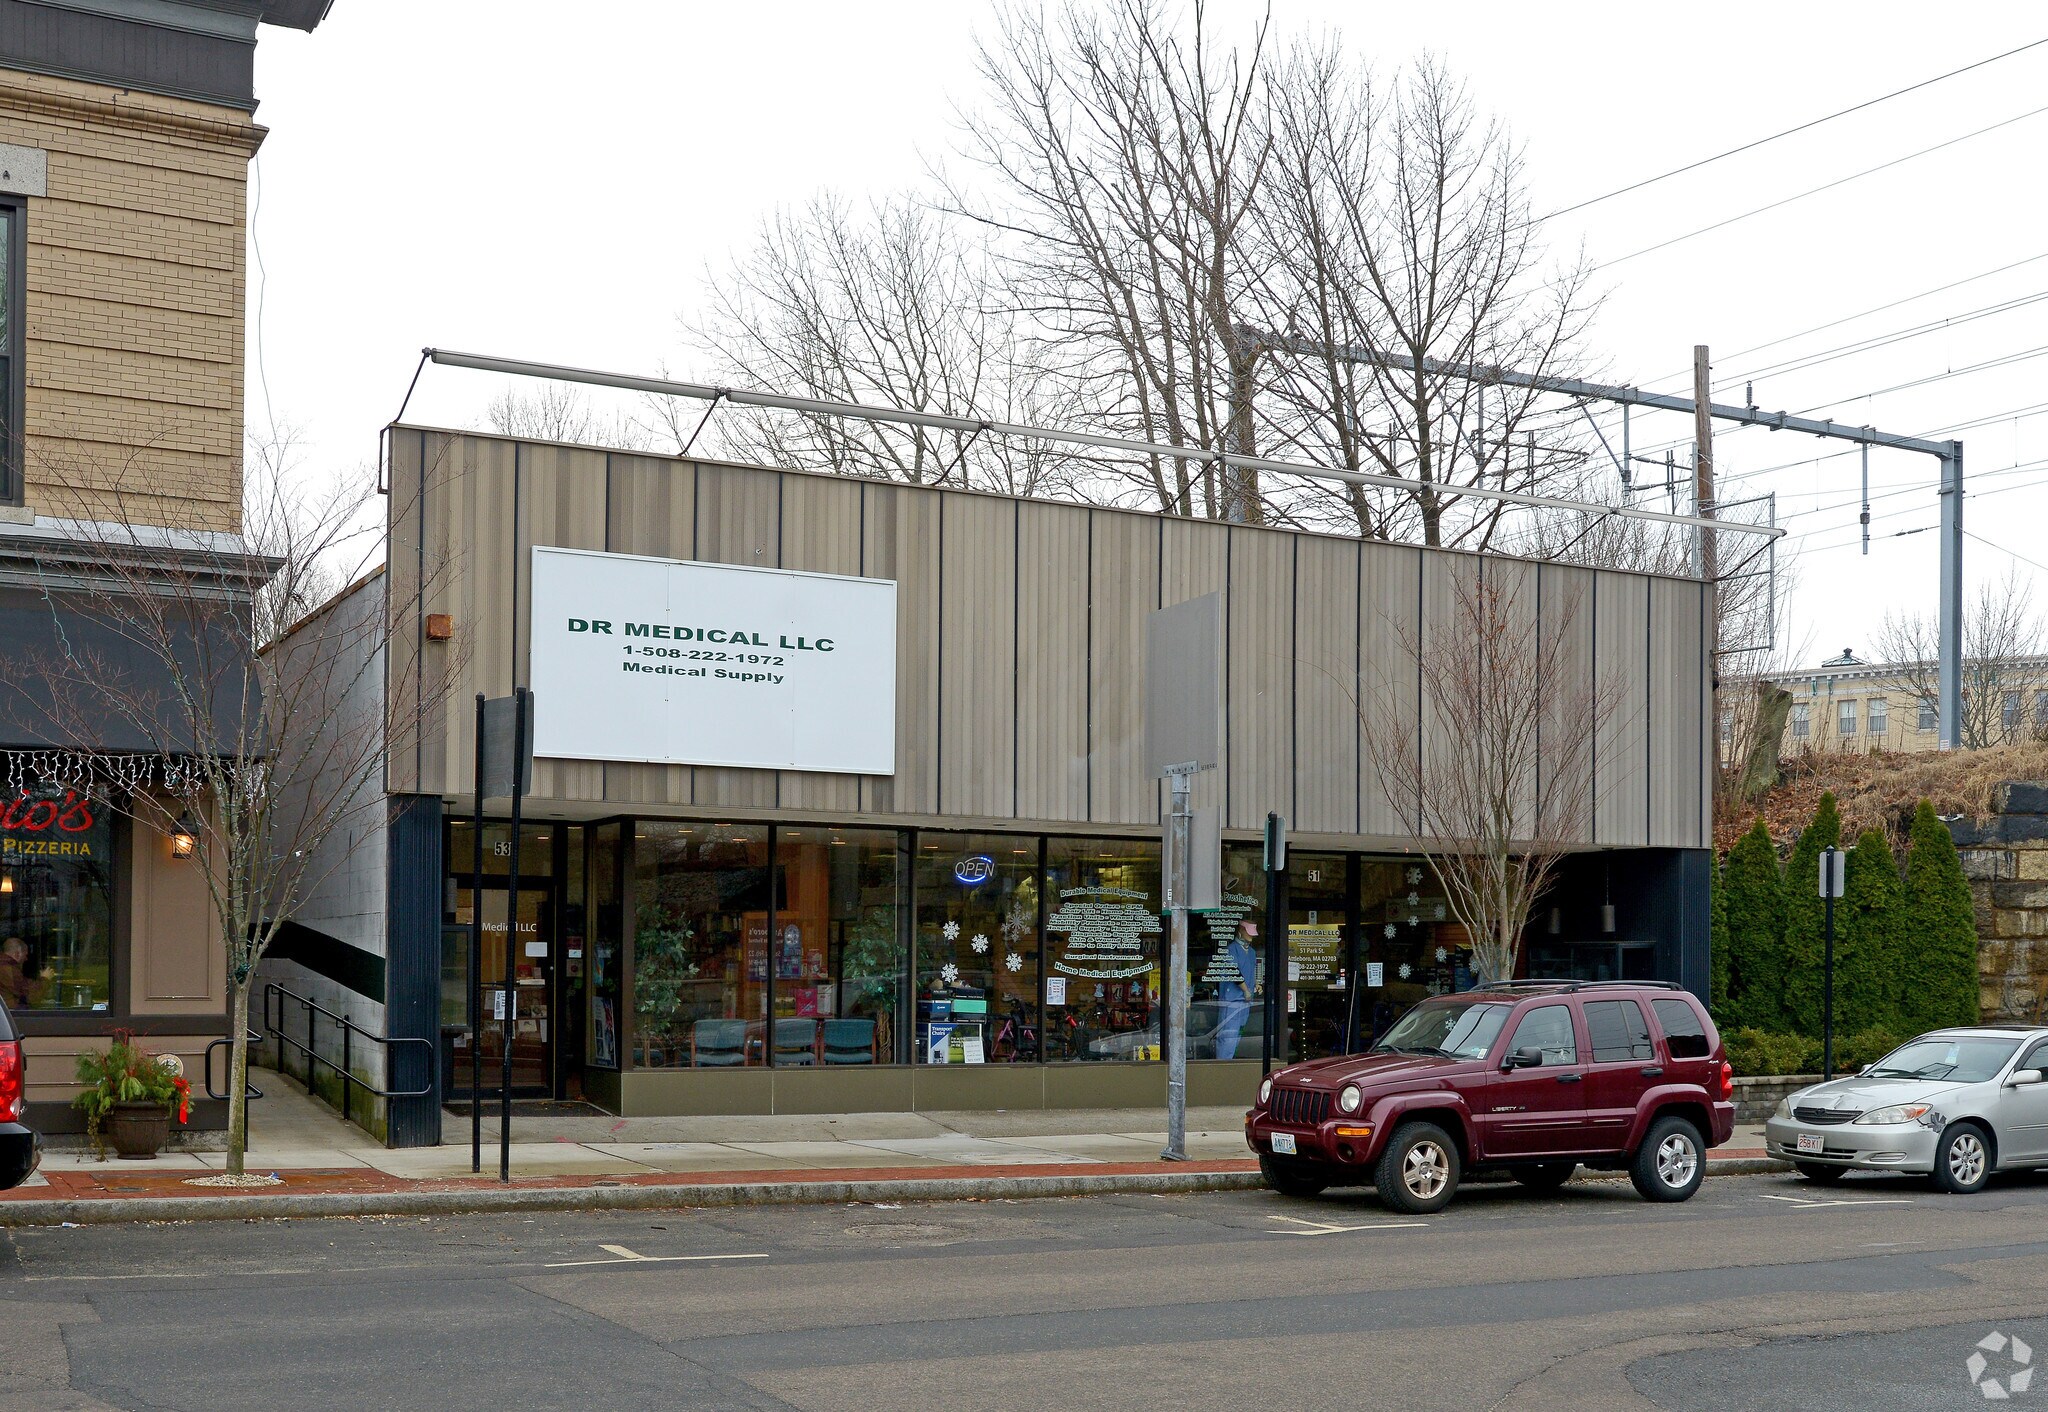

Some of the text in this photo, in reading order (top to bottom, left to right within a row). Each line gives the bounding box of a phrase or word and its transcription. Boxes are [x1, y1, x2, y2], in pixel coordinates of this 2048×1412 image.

[568, 618, 835, 651] DR MEDICAL LLC
[623, 645, 784, 666] 1-508-222-1972
[622, 662, 784, 685] Medical Supply
[495, 841, 511, 856] 53
[955, 861, 995, 877] OPEN
[1308, 870, 1320, 882] 51
[1060, 886, 1148, 900] Durable Medical Equipment
[1223, 891, 1259, 907] Prosthetics
[520, 923, 537, 932] LLC
[1054, 961, 1079, 975] Home
[1079, 968, 1111, 978] Medical
[1111, 961, 1154, 978] Equipment
